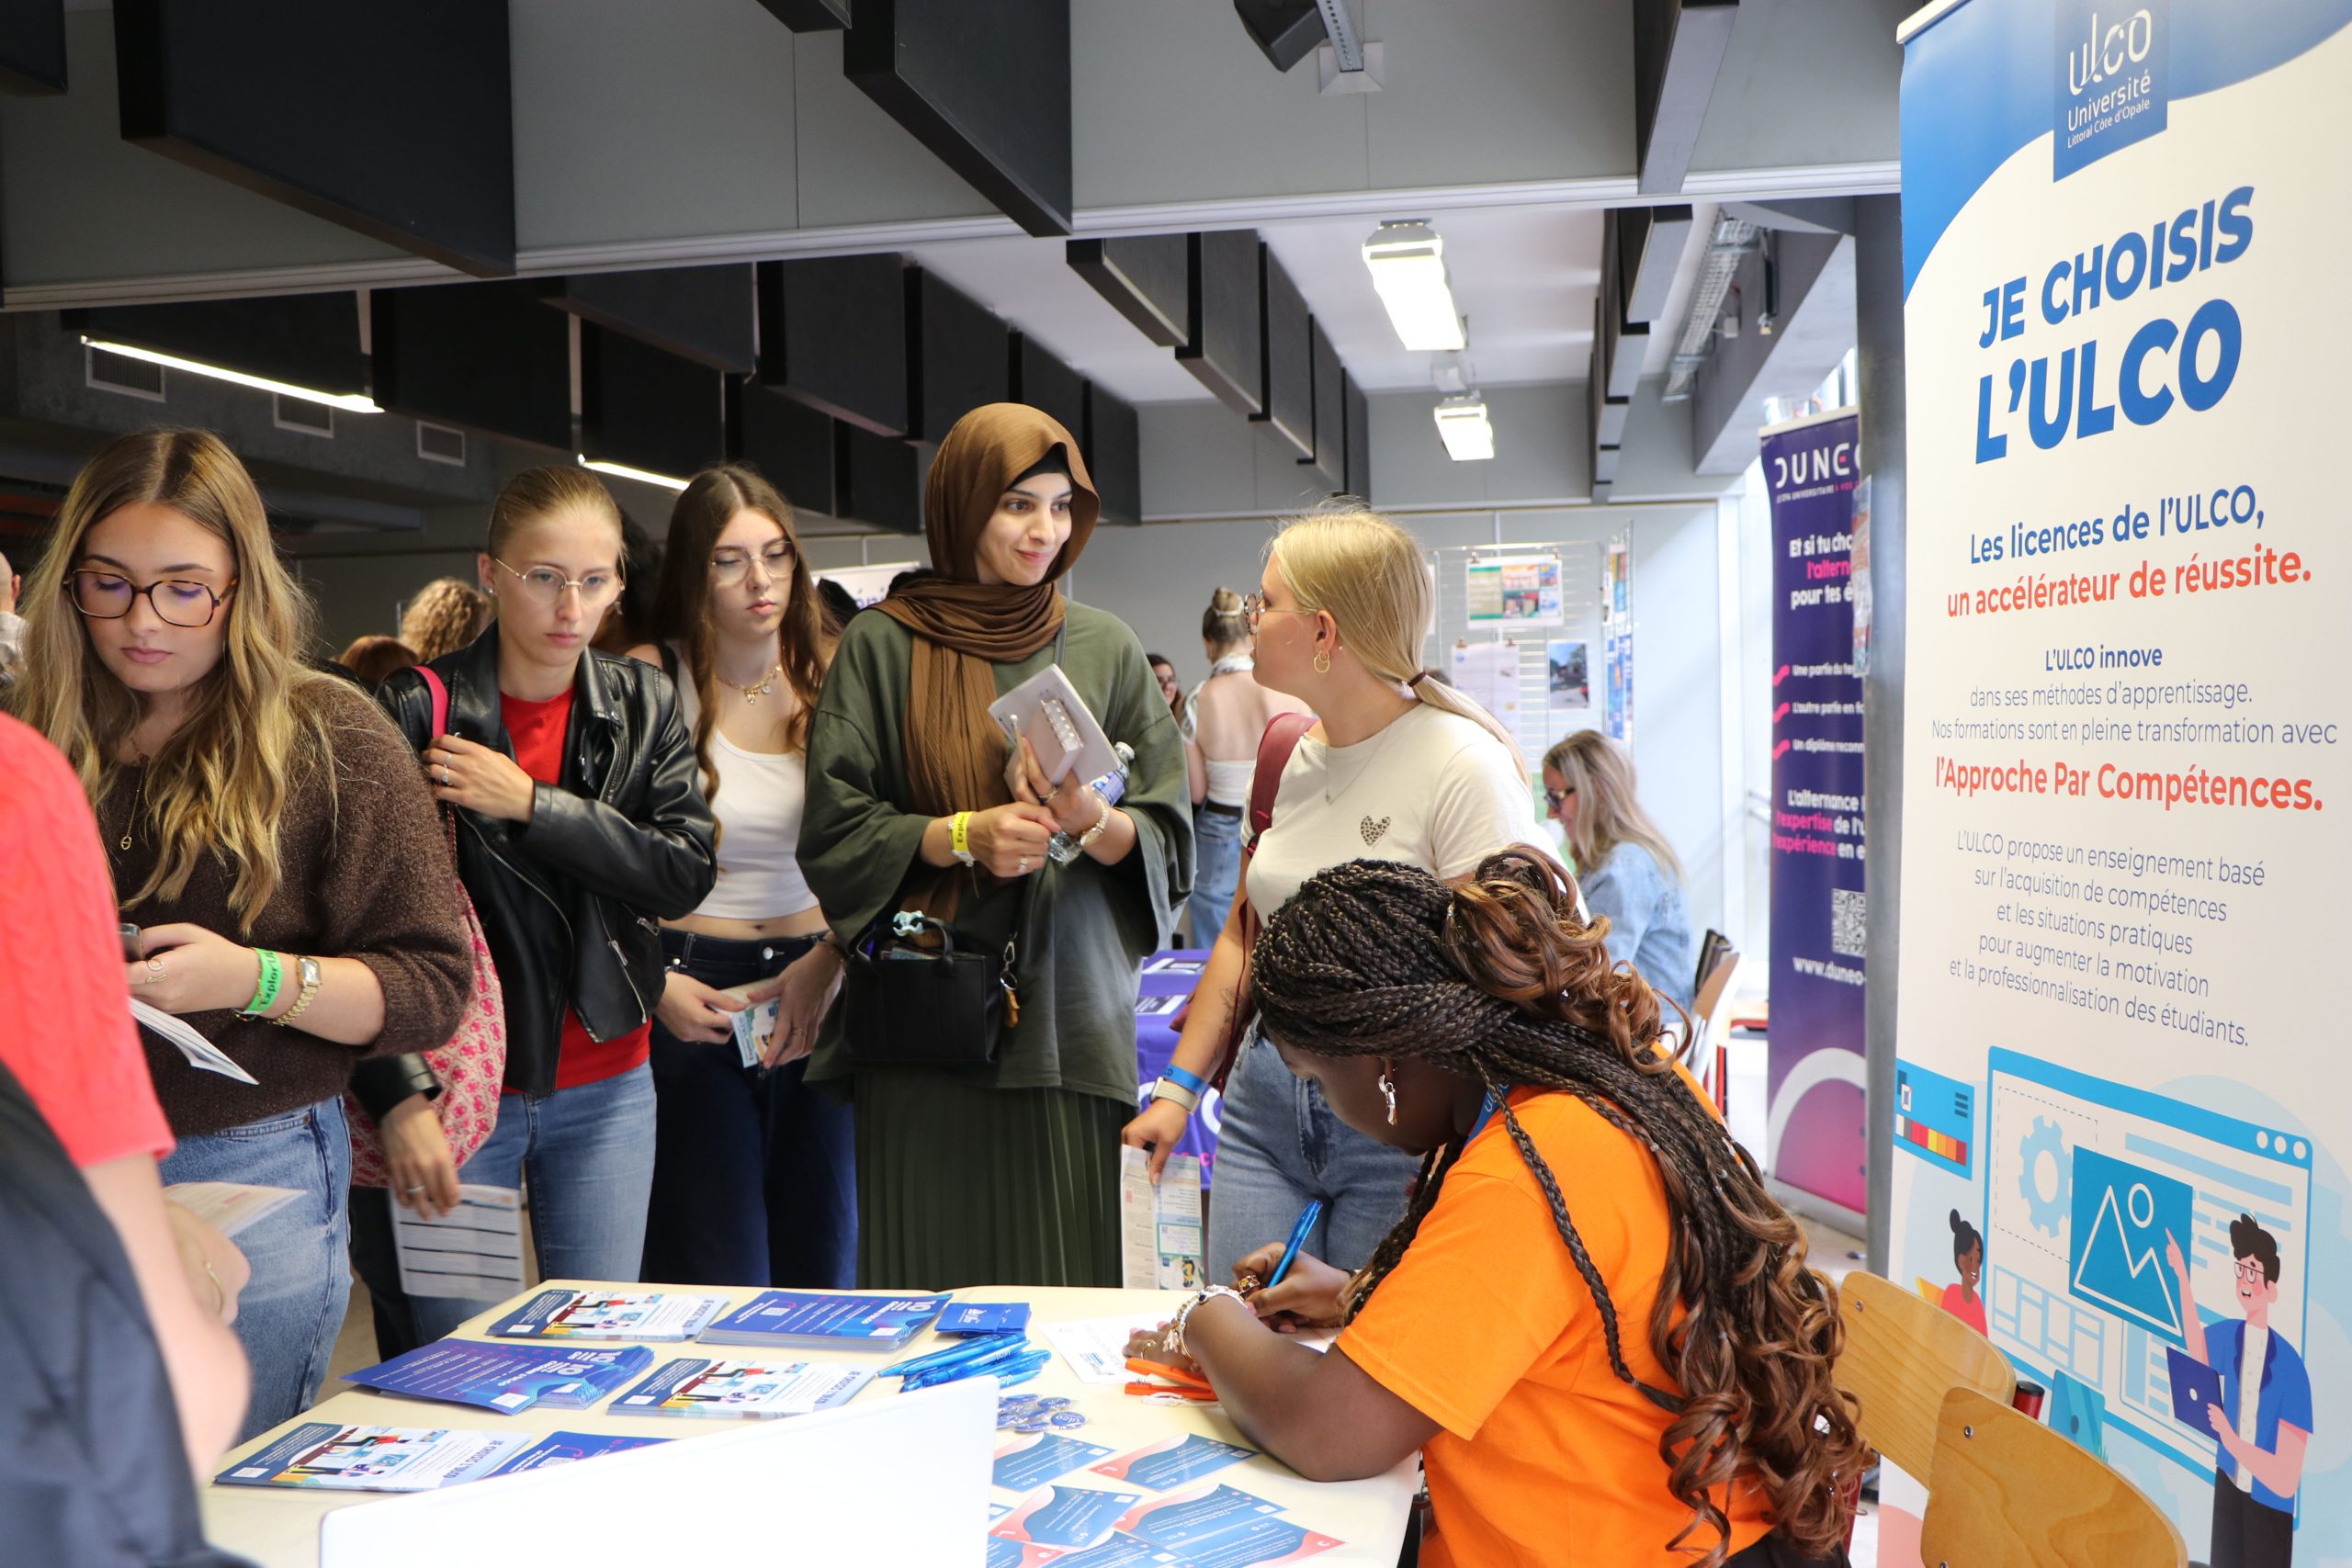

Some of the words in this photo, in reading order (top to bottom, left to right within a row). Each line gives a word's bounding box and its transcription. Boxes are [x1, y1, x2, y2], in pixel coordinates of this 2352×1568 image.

[2069, 9, 2152, 96] ulco
[2067, 124, 2093, 149] Littoral
[2094, 116, 2113, 134] Côte
[2114, 99, 2151, 123] d'Opale
[2068, 69, 2151, 132] Université
[1978, 276, 2028, 349] JE
[2041, 186, 2256, 325] CHOISIS
[1975, 299, 2243, 465] L'ULCO
[1789, 537, 1802, 558] Et
[1804, 534, 1815, 557] si
[1816, 535, 1831, 555] tu
[1971, 533, 2004, 564] Les
[2010, 515, 2104, 558] licences
[2112, 504, 2150, 542] de
[2159, 484, 2265, 536] l'ULCO,
[1807, 558, 1852, 580] l'altern
[1947, 591, 1971, 617] un
[1975, 571, 2120, 615] accélérateur
[2128, 559, 2165, 598] de
[2175, 543, 2312, 594] réussite.
[1791, 589, 1824, 611] pour
[1825, 583, 1842, 604] tes
[1792, 664, 1808, 677] Une
[1809, 661, 1833, 679] partie
[2045, 647, 2096, 671] L'ULCO
[2099, 644, 2163, 669] innove
[1820, 701, 1842, 716] partie
[1843, 703, 1855, 715] en
[1970, 685, 2002, 707] dans
[2005, 687, 2029, 706] ses
[2032, 682, 2102, 706] méthodes
[2106, 679, 2253, 710] d'apprentissage.
[1792, 739, 1804, 751] Un
[1931, 719, 1952, 739] Nos
[1954, 718, 2025, 740] formations
[2028, 721, 2058, 741] sont
[2061, 723, 2078, 741] en
[2081, 718, 2132, 746] pleine
[2136, 718, 2274, 745] transformation
[2280, 723, 2338, 745] avec
[1787, 789, 1860, 812] L'alternance
[1936, 756, 2048, 798] l'Approche
[2054, 761, 2090, 797] Par
[2098, 763, 2323, 811] Compétences.
[1772, 831, 1837, 856] l'expérience
[1838, 842, 1855, 860] en
[1776, 808, 1833, 832] l'expertise
[1833, 815, 1850, 835] de
[1957, 829, 2004, 855] L'ULCO
[2007, 836, 2064, 864] propose
[2065, 844, 2085, 865] un
[2087, 847, 2213, 881] enseignement
[2218, 856, 2266, 886] basé
[1974, 868, 1996, 888] sur
[1999, 867, 2080, 902] l'acquisition
[2083, 879, 2104, 903] de
[2108, 884, 2228, 922] compétences
[1996, 901, 2012, 922] et
[2015, 904, 2035, 927] les
[2037, 906, 2106, 941] situations
[2109, 920, 2193, 955] pratiques
[1979, 931, 2012, 955] pour
[2016, 939, 2092, 976] augmenter
[2096, 953, 2110, 976] la
[2115, 958, 2210, 998] motivation
[1950, 958, 1962, 976] et
[1964, 958, 1976, 980] la
[1978, 966, 2120, 1015] professionnalisation
[2124, 996, 2156, 1024] des
[2160, 1001, 2249, 1047] étudiants.
